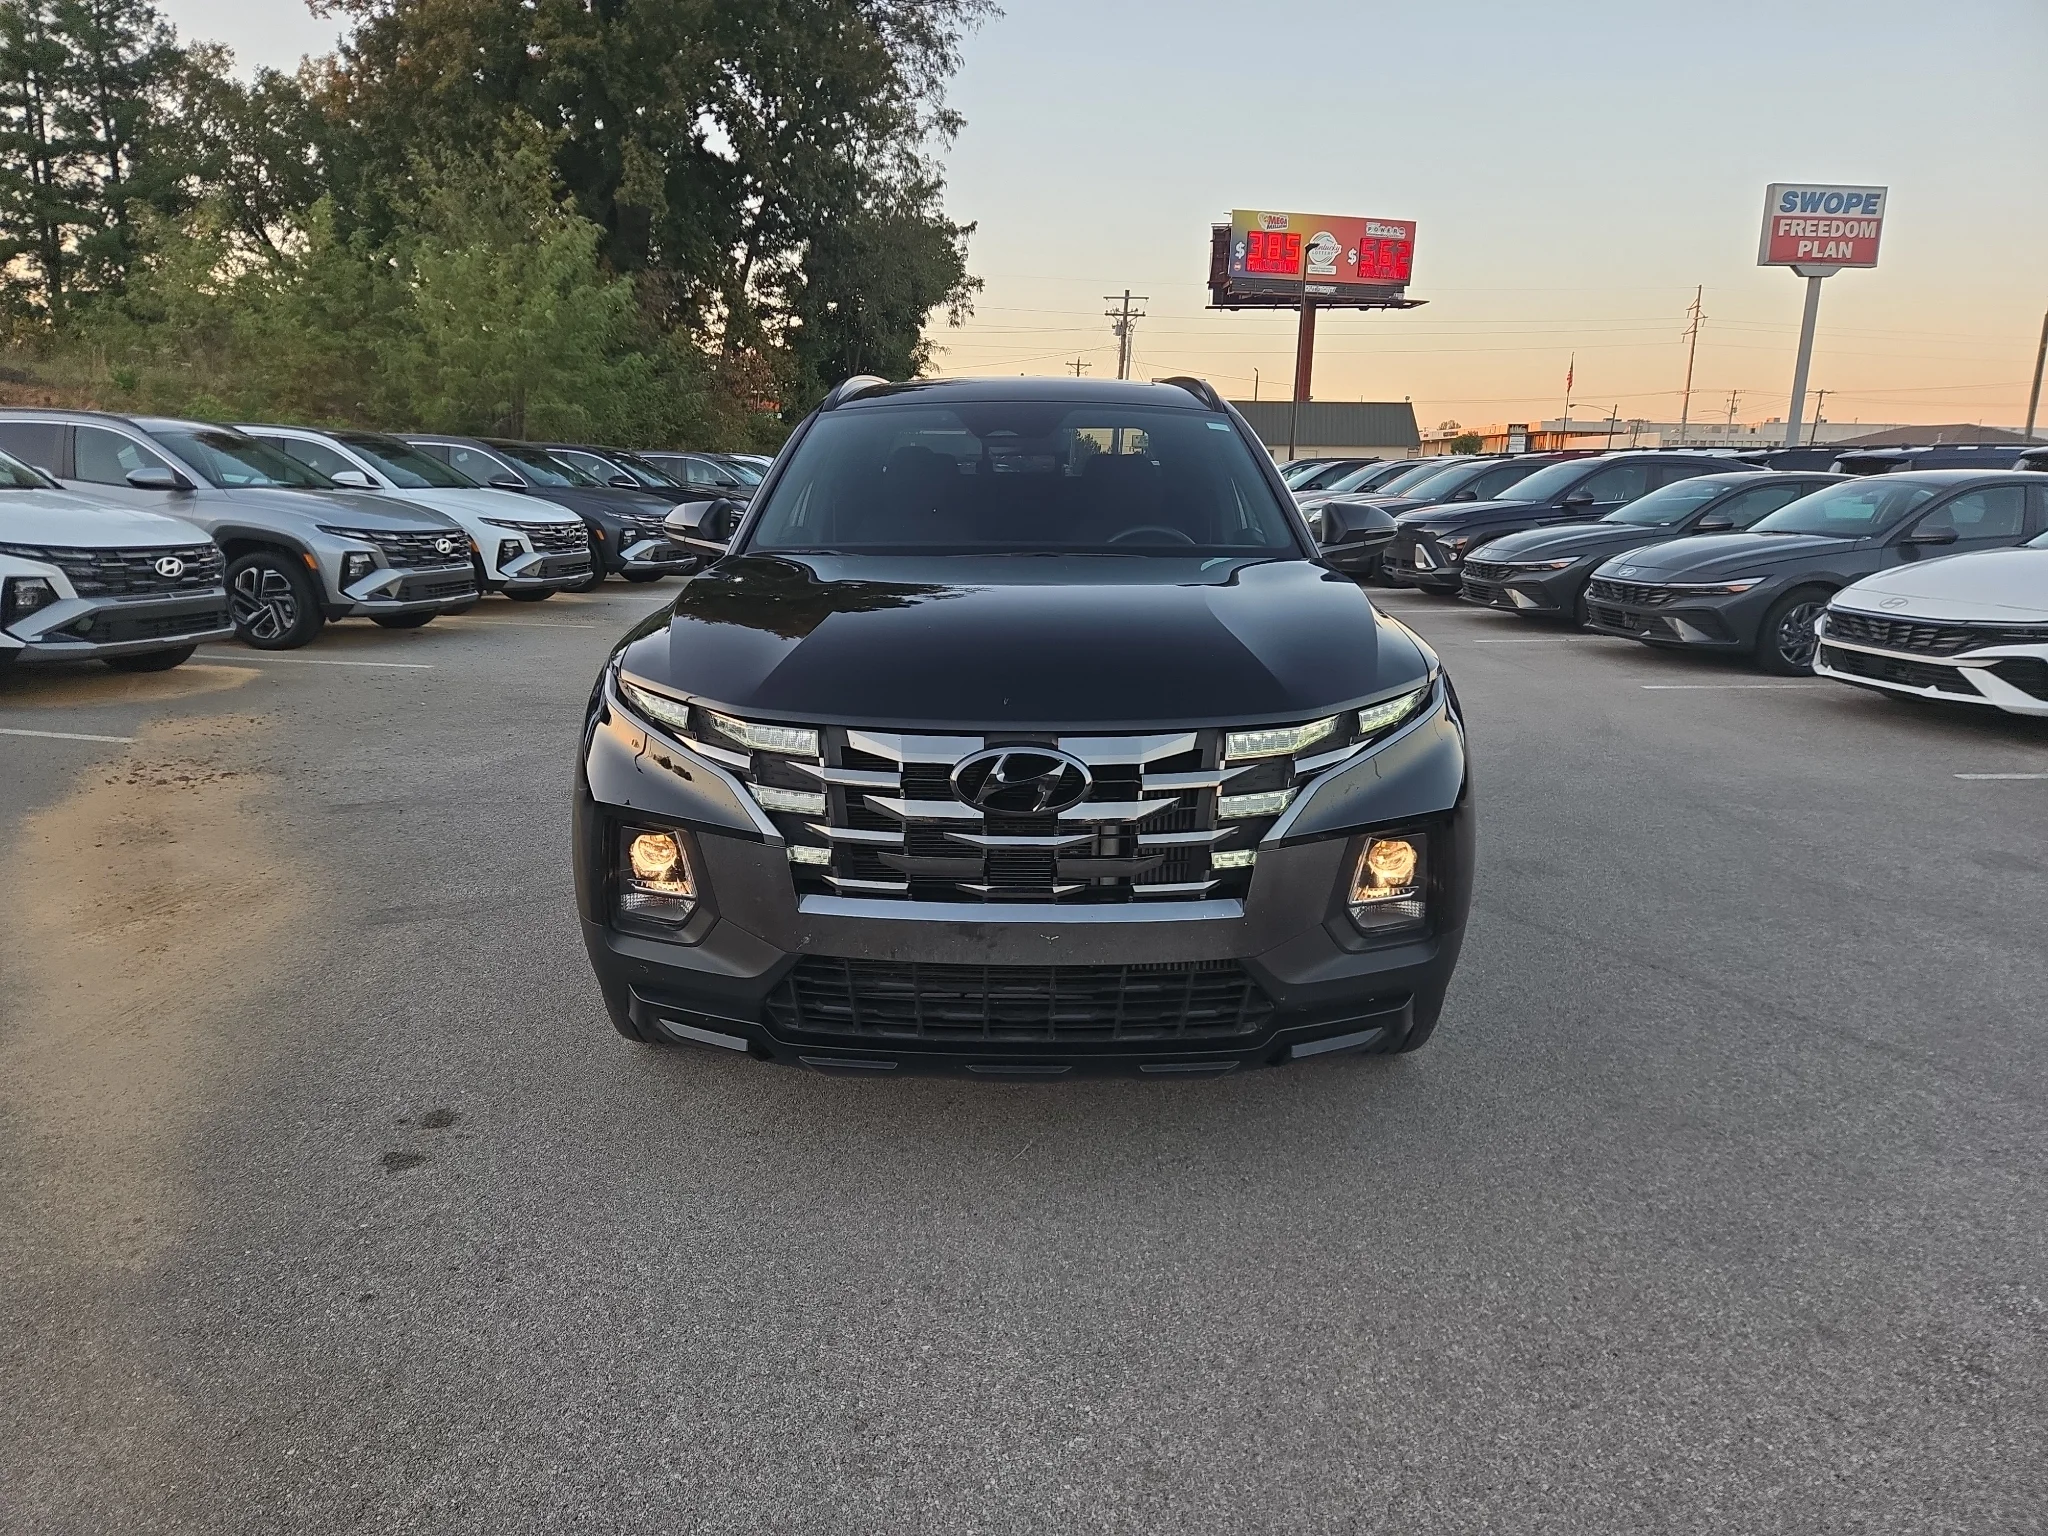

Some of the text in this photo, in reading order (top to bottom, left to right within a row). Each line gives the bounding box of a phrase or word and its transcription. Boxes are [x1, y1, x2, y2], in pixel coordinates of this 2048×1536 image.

[1779, 190, 1882, 215] SWOPE
[1777, 218, 1878, 239] FREEDOM
[1797, 240, 1854, 259] PLAN
